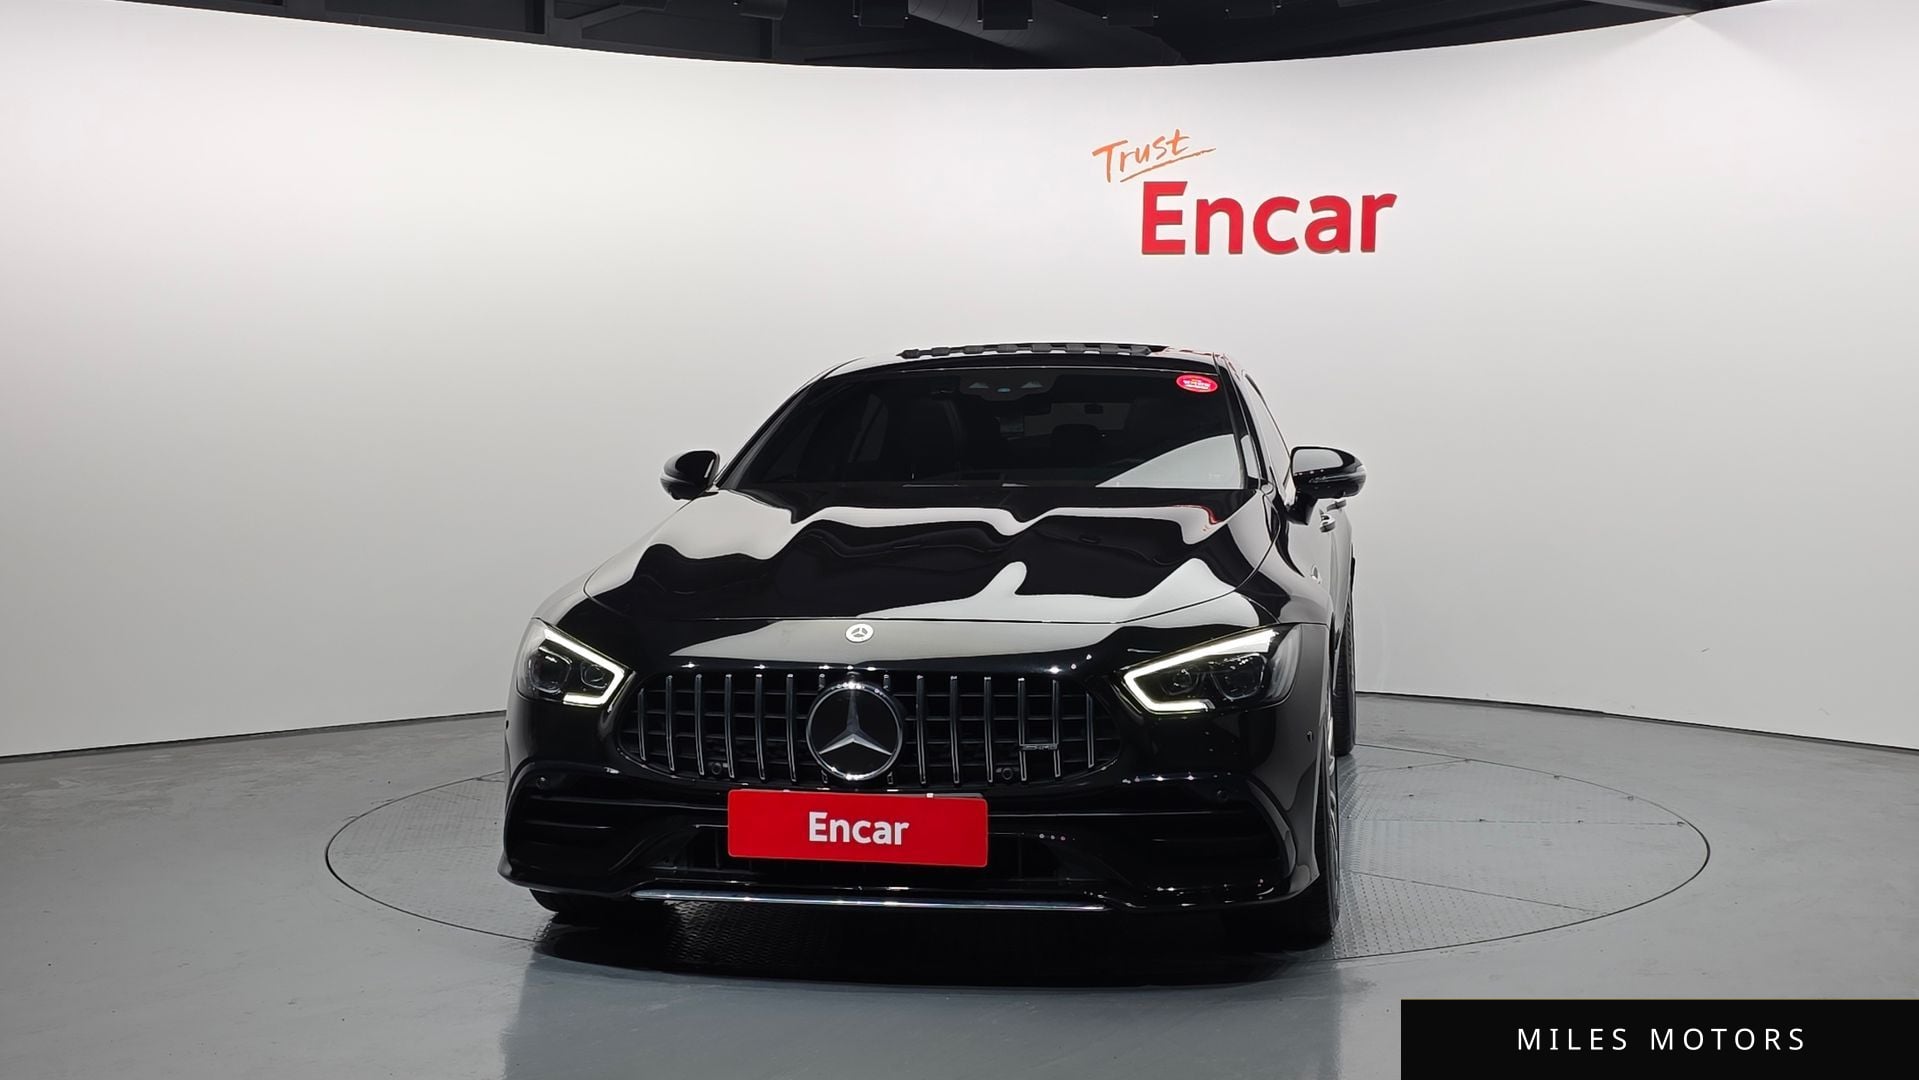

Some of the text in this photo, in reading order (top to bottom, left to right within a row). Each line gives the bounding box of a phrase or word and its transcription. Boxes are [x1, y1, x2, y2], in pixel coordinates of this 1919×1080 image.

[1092, 128, 1190, 183] Trust
[1141, 181, 1398, 255] Encar
[808, 811, 910, 846] Encar
